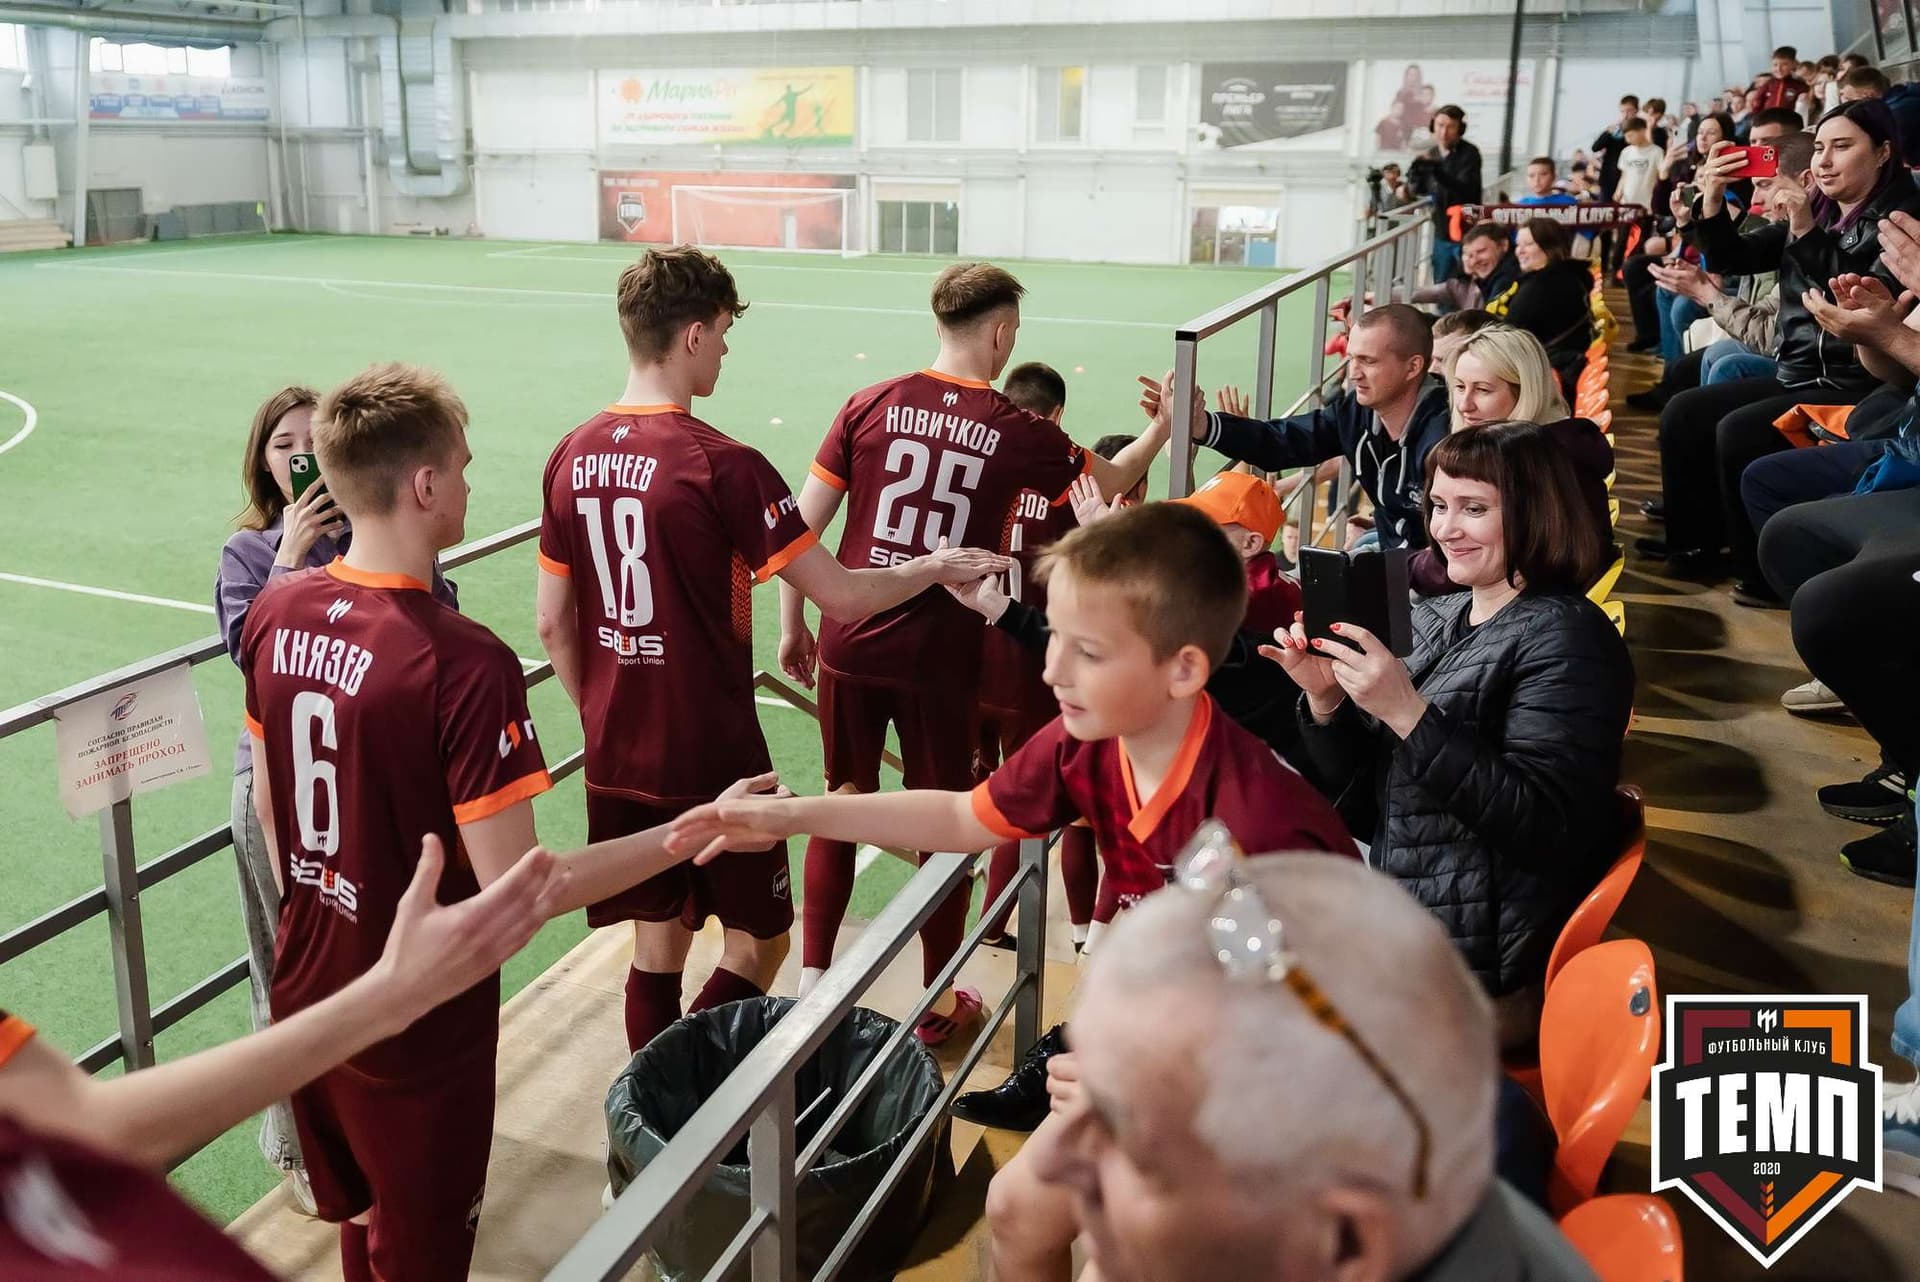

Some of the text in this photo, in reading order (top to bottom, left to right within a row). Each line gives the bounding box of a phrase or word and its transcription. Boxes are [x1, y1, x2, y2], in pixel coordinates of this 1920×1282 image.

[1579, 206, 1614, 224] КЛУБ
[885, 405, 1001, 457] НОВИЧКОВ
[572, 453, 658, 492] БРИЧЕЕВ
[872, 438, 985, 552] 25
[576, 497, 654, 628] 18
[272, 628, 374, 697] КНЯЗЕВ
[617, 656, 665, 666] Export Union
[78, 718, 174, 759] ПОЖАРНОЙ БЕЗОПАСНОСТИ
[87, 715, 164, 747] СОГЛАСНО ПРАВИЛАМ
[74, 762, 135, 790] ЗАНИМАТЬ
[138, 743, 186, 766] ПРОХОД
[94, 738, 161, 770] ЗАПРЕЩЕНО
[291, 691, 340, 857] 6
